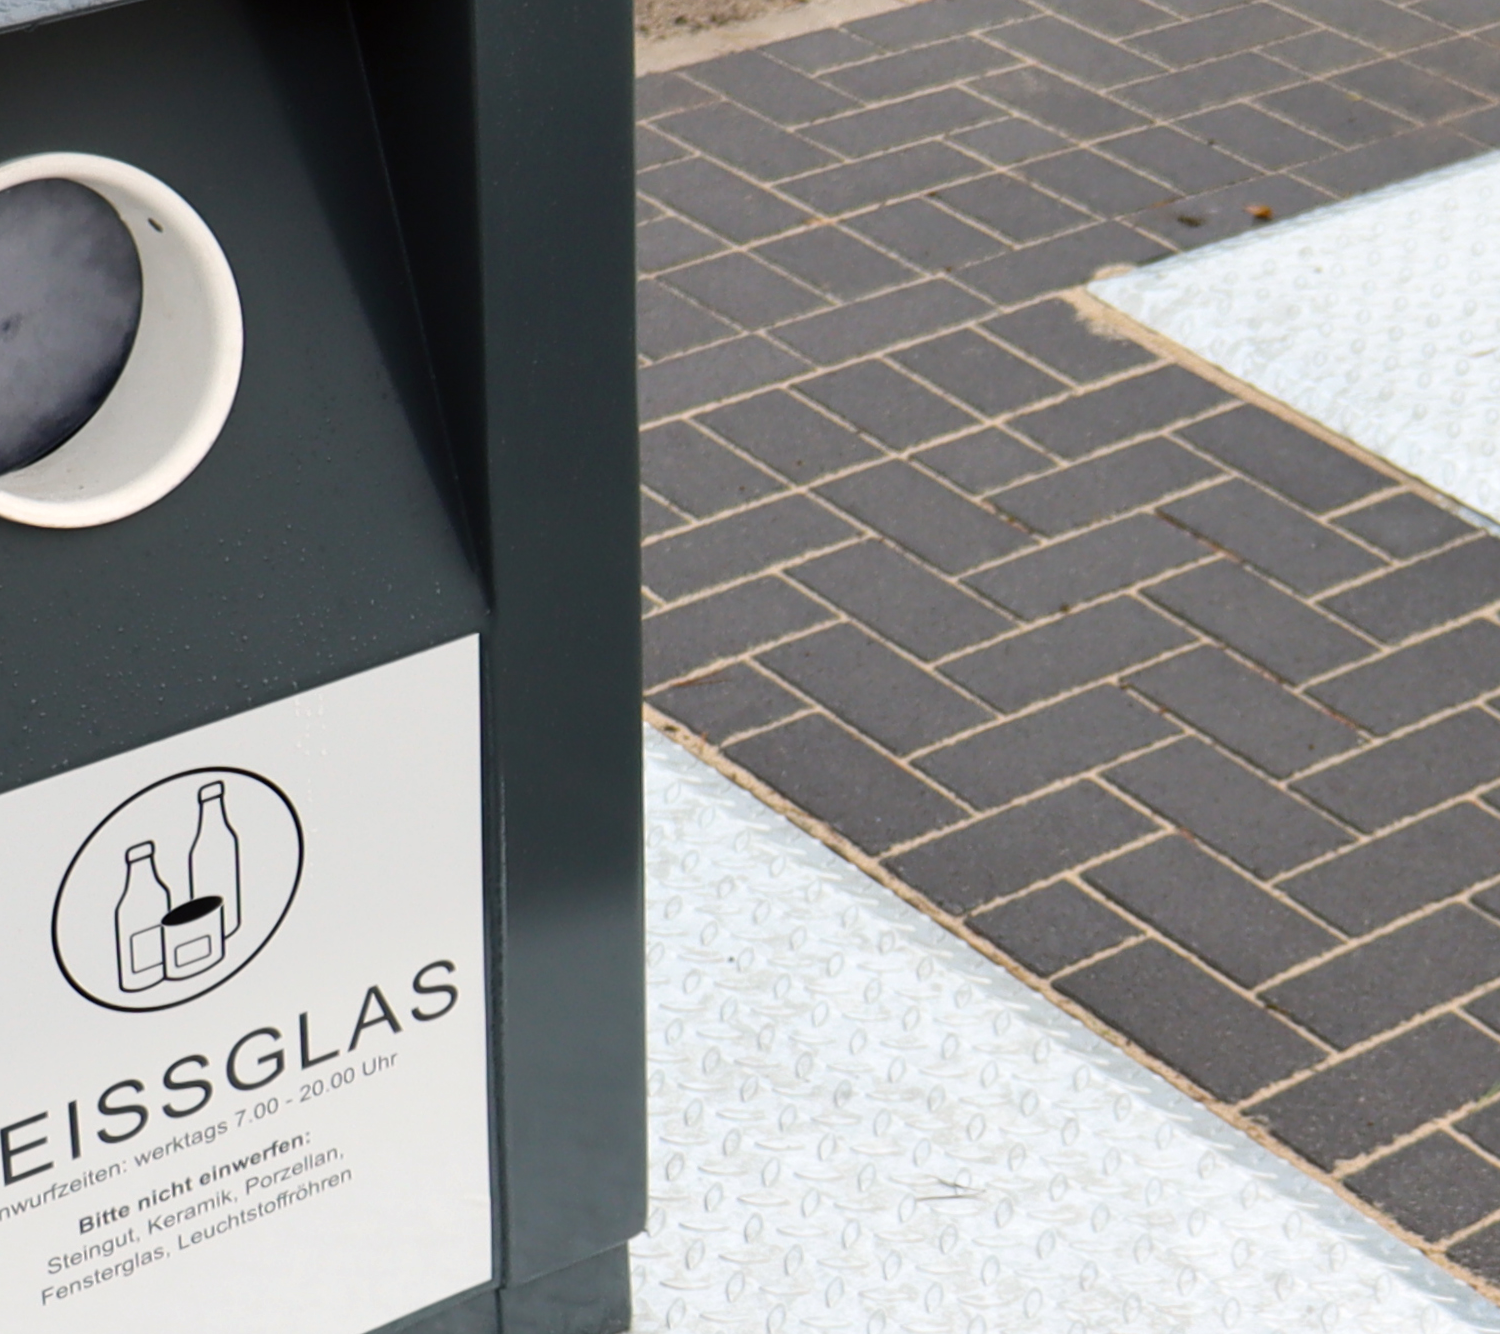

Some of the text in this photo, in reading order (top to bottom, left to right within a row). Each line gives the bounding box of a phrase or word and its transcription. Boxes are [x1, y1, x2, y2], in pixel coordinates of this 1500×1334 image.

[134, 1119, 229, 1167] werktags
[235, 1097, 279, 1128] 7.00
[299, 1066, 356, 1103] 20.00
[362, 1051, 399, 1077] Uhr
[40, 1167, 353, 1307] Fensterglas, Leuchtstoffröhren
[46, 1145, 344, 1276] Steingut, Keramik, Porzellan,
[78, 1131, 311, 1235] Bitte nicht einwerfen:
